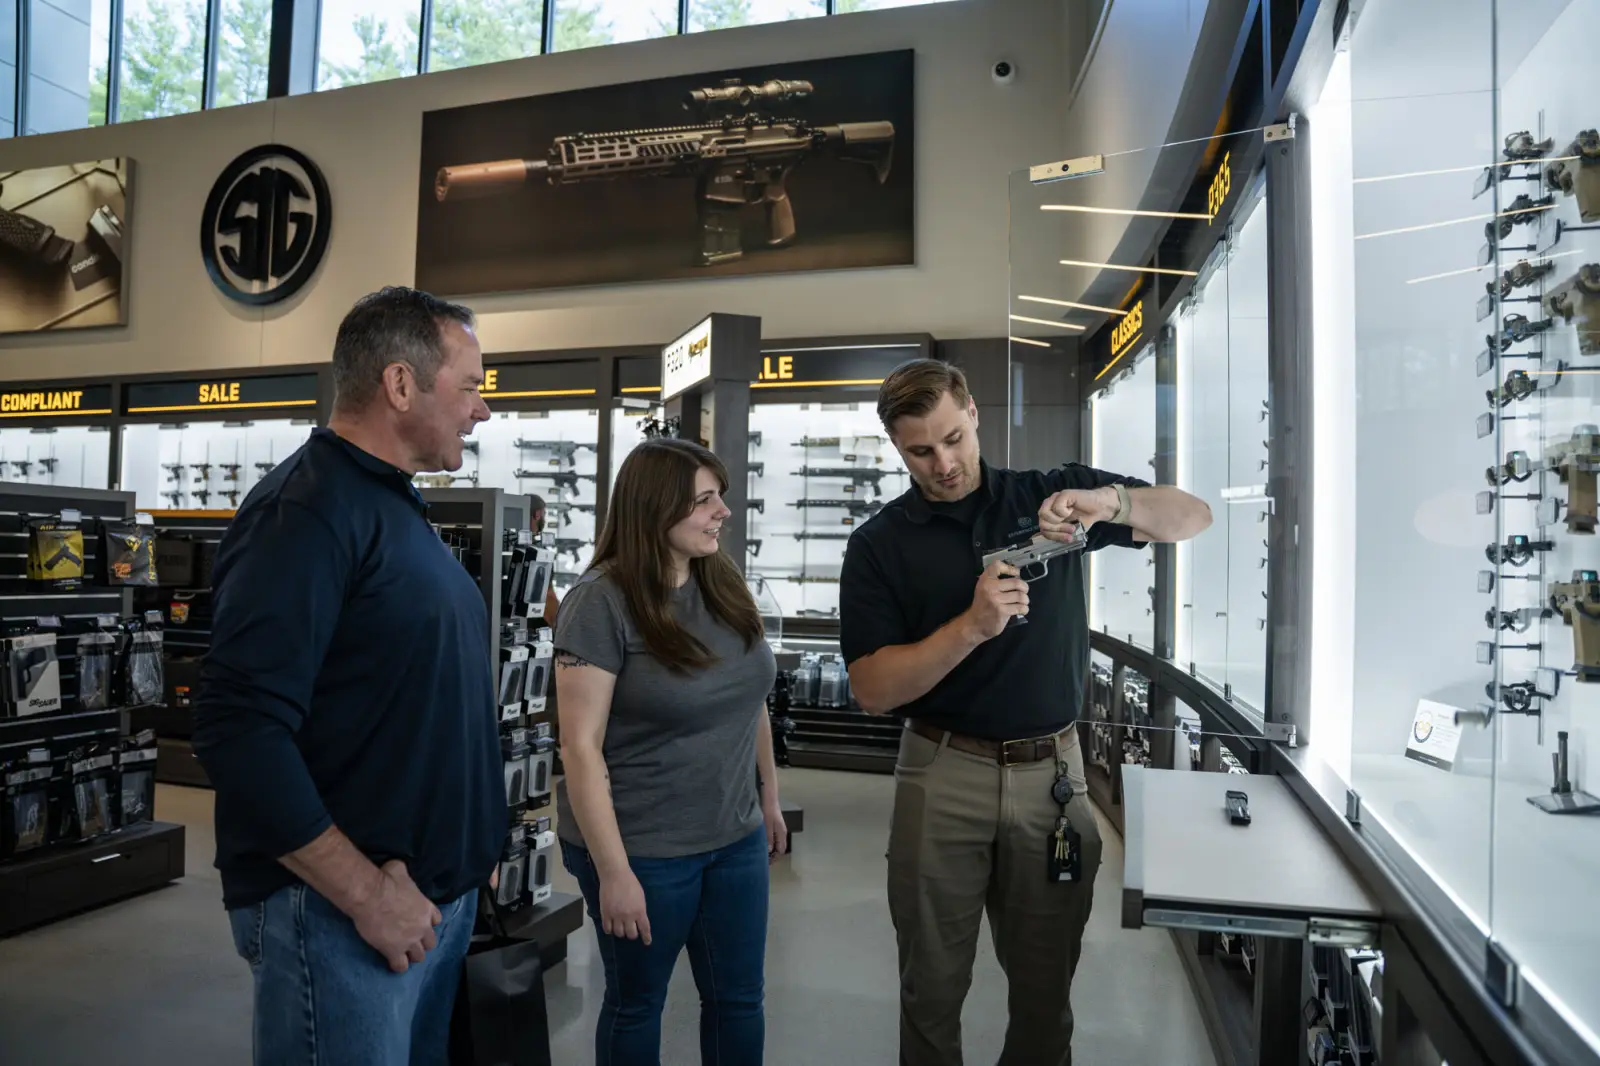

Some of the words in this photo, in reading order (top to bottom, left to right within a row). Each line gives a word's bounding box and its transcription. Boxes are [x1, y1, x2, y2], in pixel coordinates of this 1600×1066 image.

[1208, 151, 1231, 226] P365
[1111, 300, 1143, 355] CLASSICS
[759, 356, 793, 379] LE
[1, 391, 82, 411] COMPLIANT
[199, 383, 240, 403] SALE
